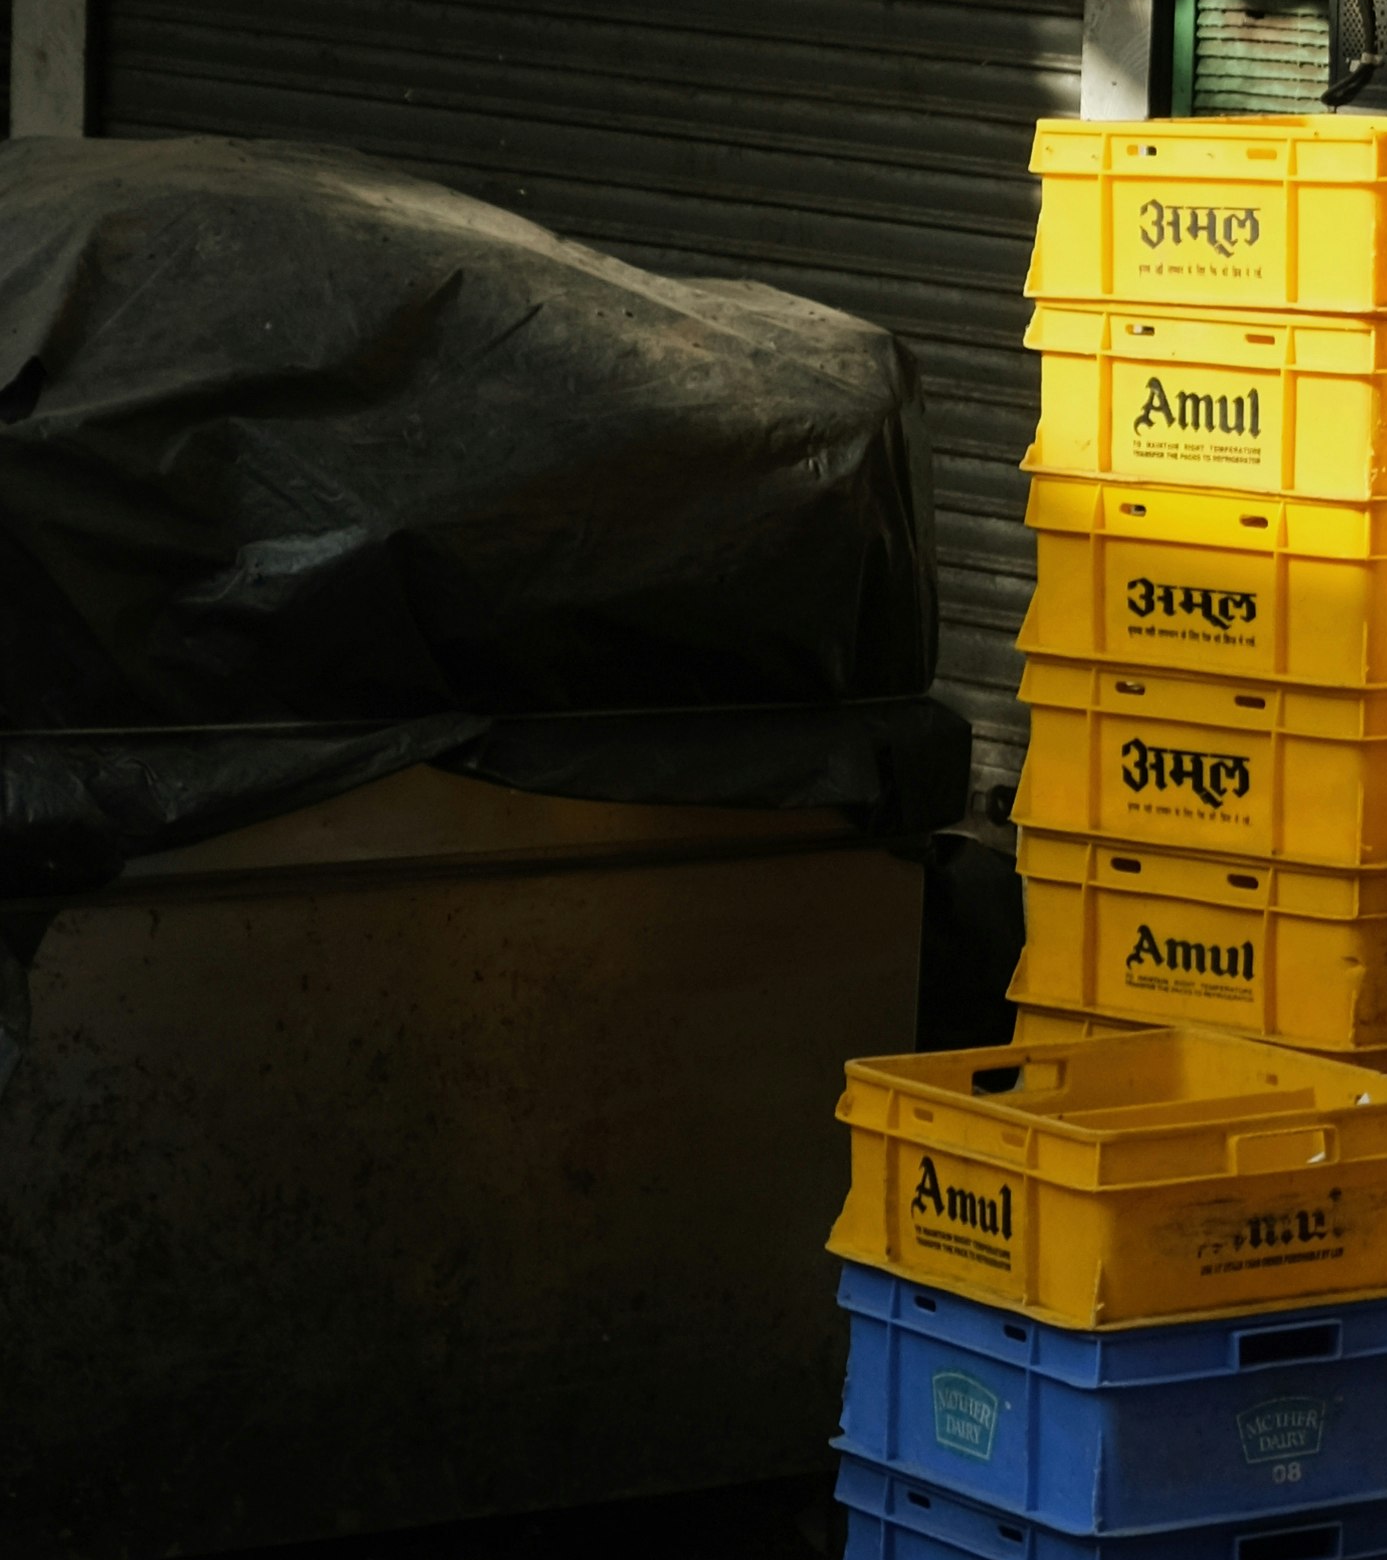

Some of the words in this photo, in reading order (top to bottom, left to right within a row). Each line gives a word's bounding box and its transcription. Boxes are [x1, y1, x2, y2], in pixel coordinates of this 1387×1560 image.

[1140, 199, 1261, 258] अमूल
[1133, 376, 1261, 439] Amul
[1127, 578, 1257, 630] अमूल
[1122, 738, 1250, 809] अमूल
[1126, 924, 1254, 981] Amul
[911, 1156, 1012, 1240] Amul
[936, 1387, 992, 1428] MOTHER
[945, 1413, 983, 1445] DAIRY
[1245, 1408, 1318, 1439] MOTHER
[1260, 1429, 1307, 1452] DAIRY
[1272, 1462, 1302, 1484] 08
